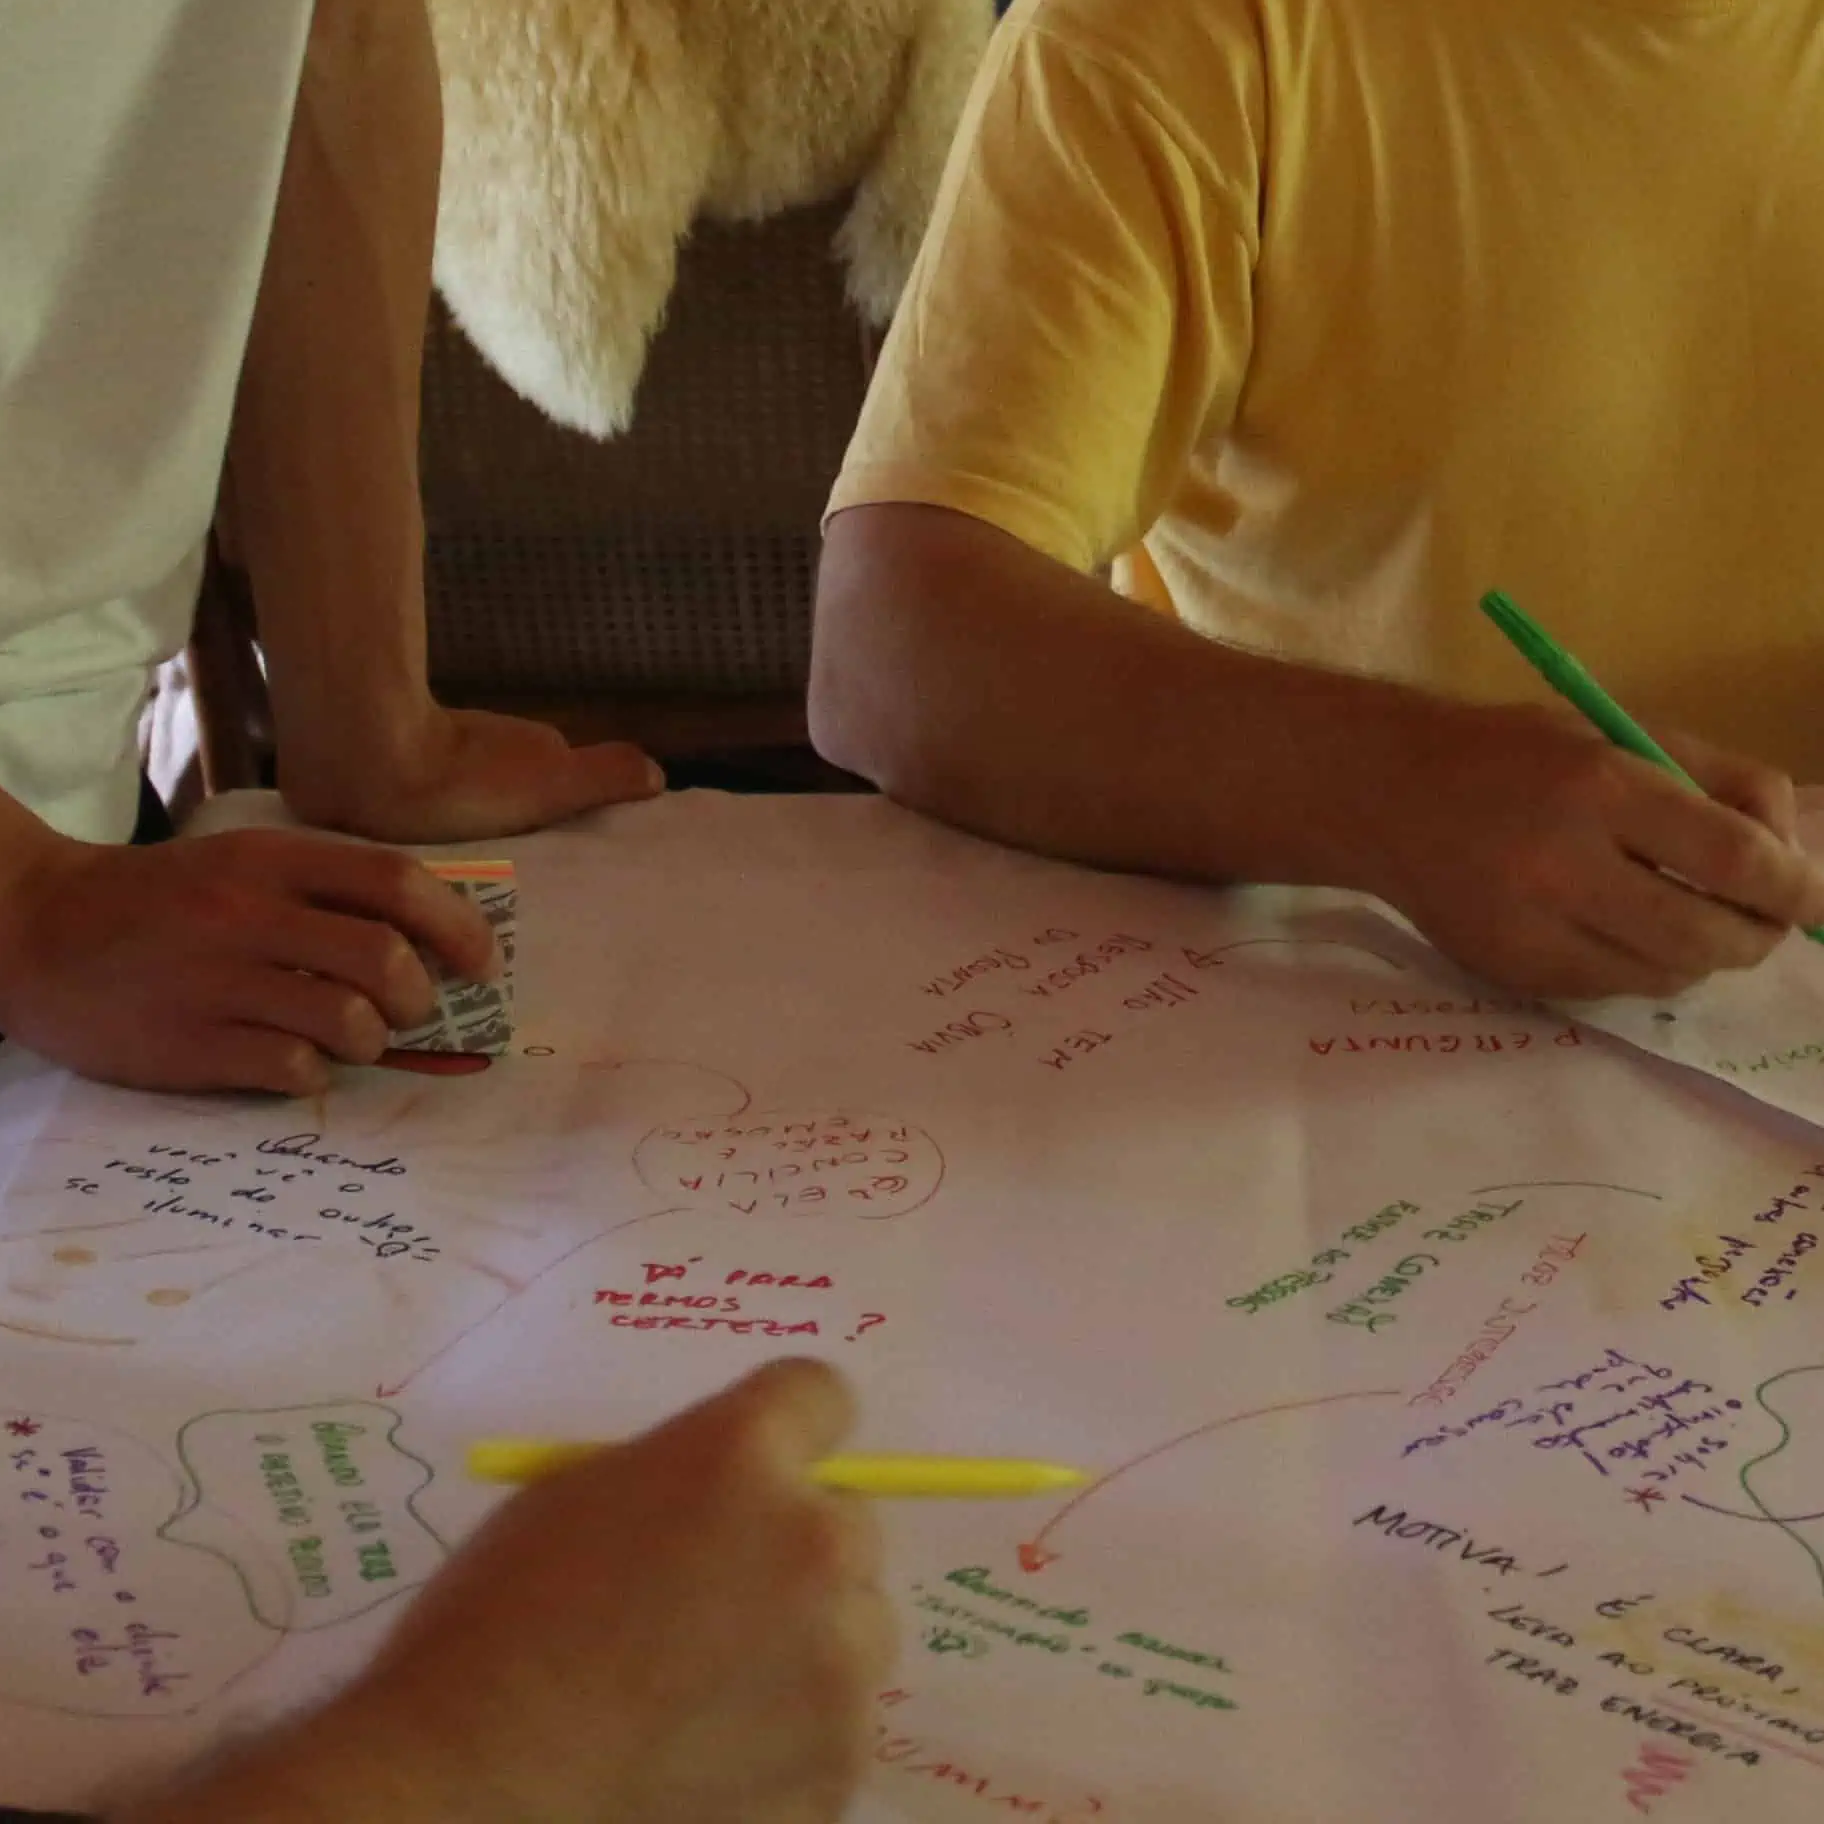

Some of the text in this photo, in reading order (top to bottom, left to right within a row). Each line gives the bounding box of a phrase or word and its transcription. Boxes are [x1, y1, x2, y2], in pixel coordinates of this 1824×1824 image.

[1307, 1026, 1582, 1057] PERGUNTA
[640, 1255, 835, 1289] DÁ PARA
[591, 1287, 741, 1313] TERMOS
[608, 1313, 819, 1337] CERTEZA
